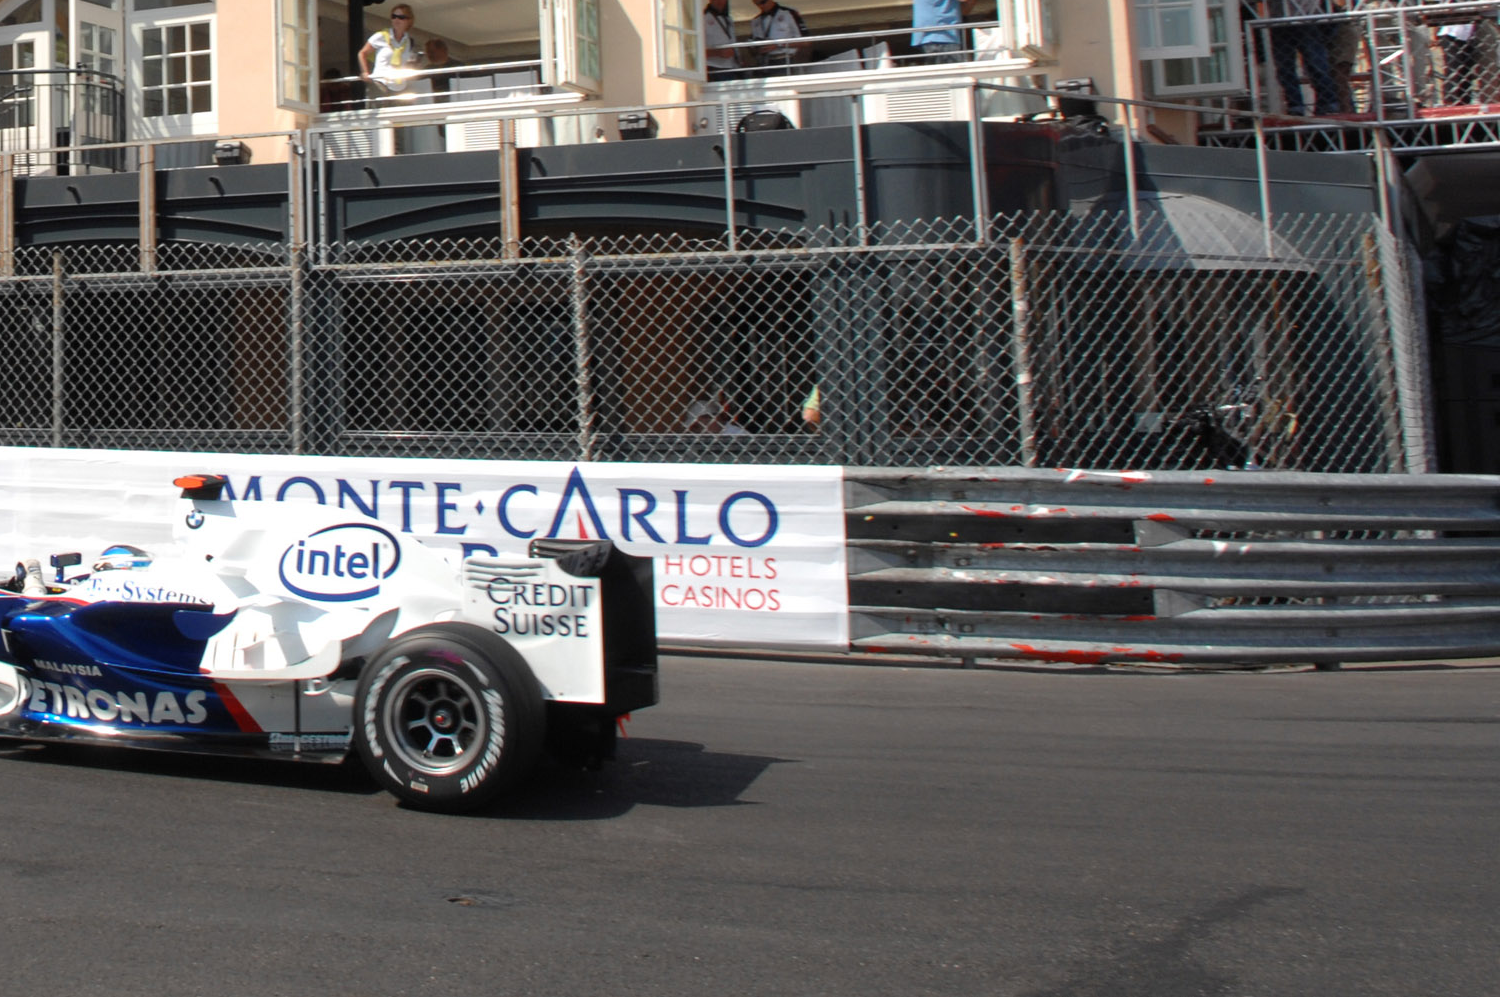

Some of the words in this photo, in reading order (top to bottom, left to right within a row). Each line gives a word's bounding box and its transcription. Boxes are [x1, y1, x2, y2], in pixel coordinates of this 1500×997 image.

[297, 539, 380, 580] intel
[664, 554, 778, 580] HOTELS
[660, 583, 781, 611] CASINOS
[33, 659, 103, 678] MALAYSIA
[17, 674, 208, 724] PETRONAS
